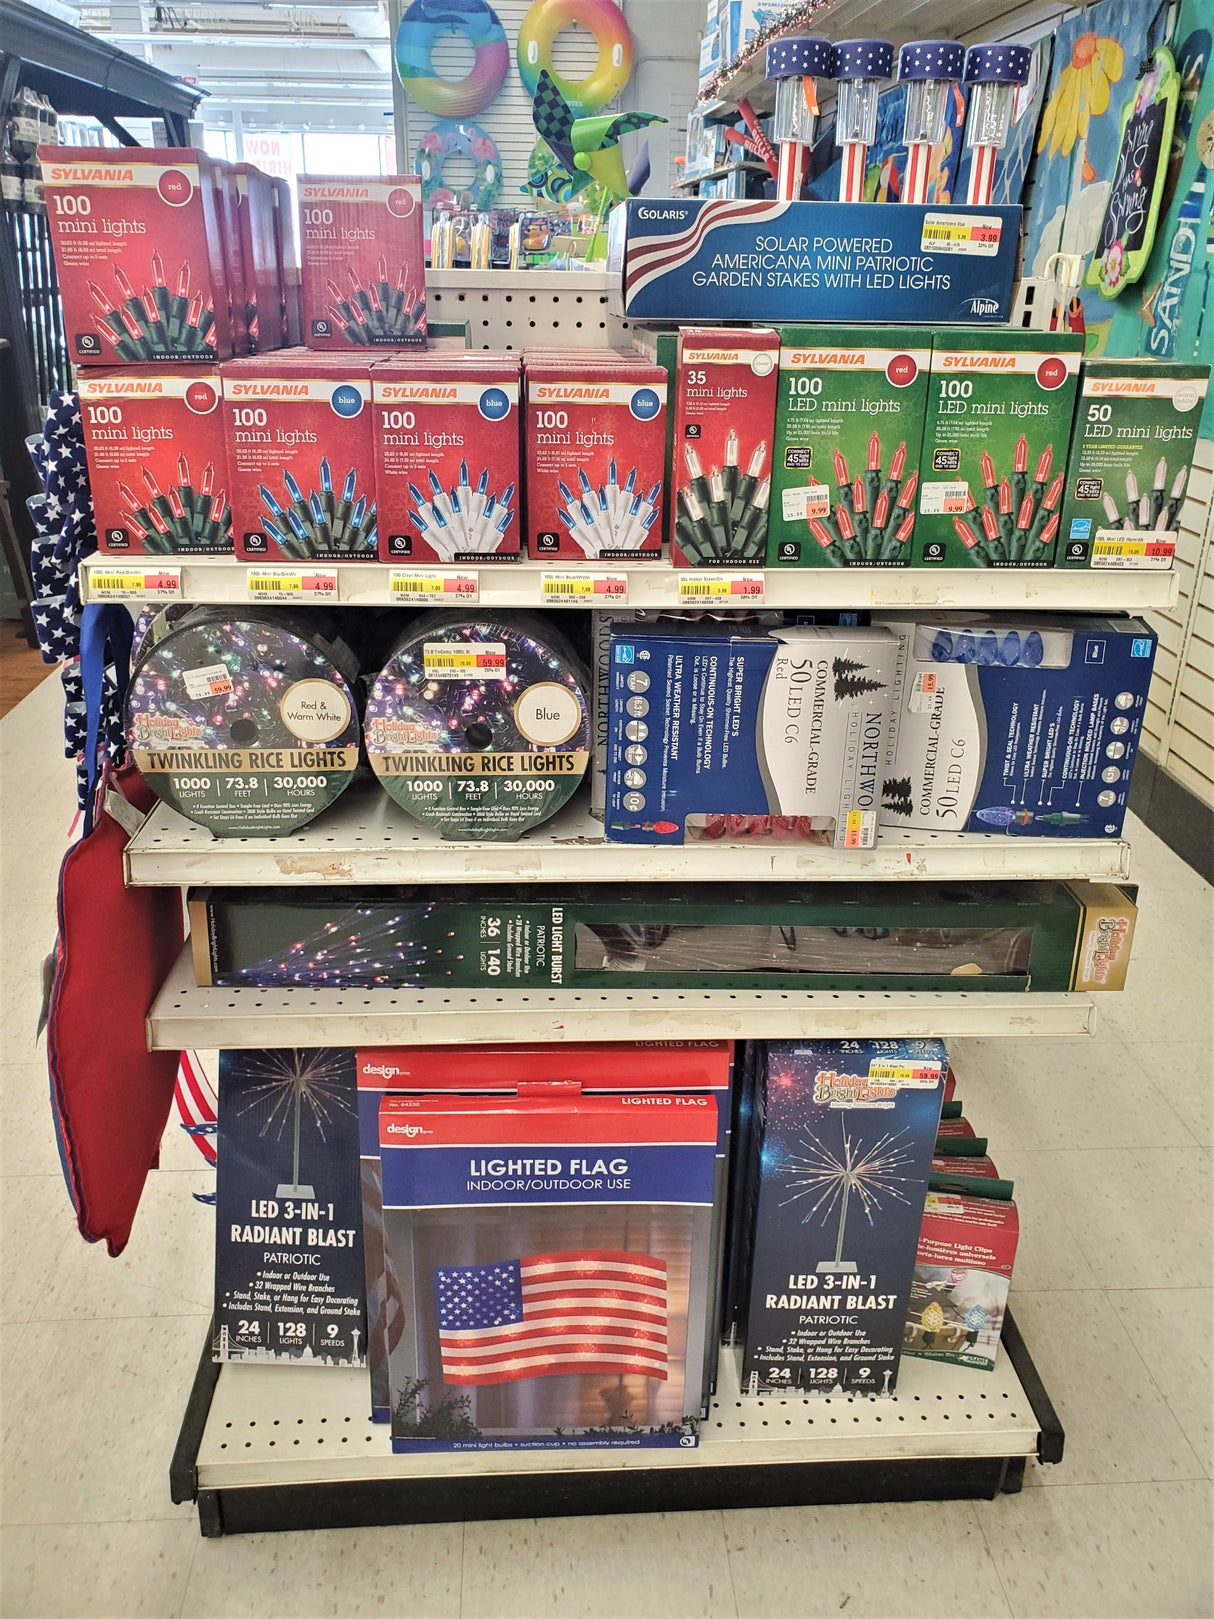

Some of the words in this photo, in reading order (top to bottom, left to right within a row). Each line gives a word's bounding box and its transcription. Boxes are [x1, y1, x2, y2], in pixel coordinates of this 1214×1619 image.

[51, 168, 133, 181] SYLVANIA
[304, 187, 369, 198] SYLVANIA
[53, 195, 91, 215] 100
[304, 209, 333, 225] 100
[57, 219, 98, 233] mini
[102, 219, 147, 237] lights
[305, 228, 337, 239] mini
[340, 228, 376, 242] lights
[755, 236, 808, 252] SOLAR
[813, 237, 893, 253] POWERED
[981, 234, 997, 243] 3.99
[712, 254, 812, 270] AMERICANA
[817, 255, 851, 271] MINI
[856, 256, 934, 272] PATRIOTIC
[692, 271, 763, 287] GARDEN
[766, 272, 820, 288] STAKES
[824, 273, 861, 289] WITH
[866, 274, 895, 289] LED
[899, 274, 951, 290] LIGHTS
[1150, 227, 1196, 355] SAND
[970, 298, 999, 315] Alpine
[688, 352, 738, 361] SYLVANIA
[791, 353, 865, 365] SYLVANIA
[943, 356, 1016, 367] SYLVANIA
[687, 371, 706, 385] 35
[788, 377, 822, 395] 100
[86, 383, 163, 394] SYLVANIA
[232, 384, 309, 395] SYLVANIA
[381, 387, 457, 399] SYLVANIA
[536, 387, 610, 399] SYLVANIA
[717, 387, 748, 400] lights
[939, 380, 973, 398] 100
[1091, 382, 1156, 392] SYLVANIA
[88, 406, 122, 424] 100
[788, 397, 817, 411] LED
[821, 399, 856, 412] mini
[860, 399, 900, 416] lights
[938, 401, 967, 414] LED
[971, 402, 1005, 415] mini
[1010, 402, 1049, 418] lights
[1087, 404, 1112, 421] 50
[233, 408, 267, 426] 100
[381, 411, 415, 429] 100
[536, 411, 568, 428] 100
[91, 427, 128, 440] mini
[131, 426, 173, 443] lights
[235, 429, 272, 442] mini
[276, 429, 317, 446] lights
[383, 432, 419, 445] mini
[423, 432, 464, 449] lights
[536, 432, 571, 445] mini
[575, 431, 614, 448] lights
[1084, 424, 1113, 438] LED
[1116, 425, 1150, 438] mini
[1154, 425, 1193, 441] lights
[811, 507, 827, 515] 9.99
[1151, 547, 1173, 557] 10.99
[158, 580, 177, 589] 4.99
[315, 582, 334, 590] 4.99
[743, 586, 761, 594] 1.99
[482, 659, 505, 667] 59.99
[674, 655, 683, 679] ULTRA
[735, 656, 745, 682] SUPER
[776, 658, 789, 680] Red
[790, 659, 813, 684] 50
[214, 684, 232, 694] 59.99
[301, 701, 317, 710] Red
[672, 682, 682, 718] WEATHER
[732, 685, 742, 713] BRIGHT
[786, 687, 803, 719] LED
[286, 712, 314, 721] Warm
[315, 712, 342, 722] White
[535, 707, 561, 720] Blue
[731, 715, 740, 736] LED'S
[805, 660, 828, 794] COMMERCIAL-GRADE
[670, 720, 680, 760] RESISTANT
[147, 752, 243, 769] TWINKLING
[249, 752, 282, 769] RICE
[290, 751, 347, 768] LIGHTS
[382, 755, 475, 772] TWINKLING
[481, 755, 514, 772] RICE
[520, 754, 575, 772] LIGHTS
[857, 713, 883, 811] NORTHWO
[173, 777, 211, 790] 1000
[225, 777, 259, 789] 73.8
[273, 776, 328, 790] 30,000
[406, 780, 443, 792] 1000
[457, 780, 489, 792] 73.8
[503, 780, 555, 793] 30,000
[945, 764, 963, 794] LED
[179, 790, 206, 798] LIGHTS
[287, 789, 316, 797] HOURS
[936, 796, 958, 818] 50
[552, 907, 563, 924] LED
[487, 917, 501, 937] 36
[536, 925, 545, 967] PATRIOTIC
[551, 926, 563, 953] LIGHT
[487, 949, 501, 976] 140
[551, 955, 562, 984] BURST
[362, 1063, 400, 1079] design
[621, 1097, 672, 1105] LIGHTED
[675, 1098, 708, 1106] FLAG
[386, 1123, 424, 1138] design
[470, 1159, 563, 1176] LIGHTED
[569, 1158, 629, 1176] FLAG
[467, 1179, 603, 1192] INDOOR/OUTDOOR
[607, 1177, 631, 1190] USE
[251, 1200, 279, 1219] LED
[284, 1201, 334, 1221] 3-IN-1
[231, 1225, 303, 1245] RADIANT
[307, 1229, 356, 1248] BLAST
[954, 1242, 973, 1251] Light
[263, 1252, 321, 1266] PATRIOTIC
[262, 1270, 283, 1279] Indoor
[293, 1272, 317, 1281] Outdoor
[319, 1273, 330, 1282] Use
[788, 1274, 819, 1290] LED
[823, 1274, 877, 1290] 3-IN-1
[228, 1303, 253, 1311] Includes
[306, 1306, 318, 1314] and
[320, 1306, 342, 1315] Ground
[344, 1307, 360, 1316] Stake
[765, 1294, 842, 1309] RADIANT
[846, 1295, 897, 1310] BLAST
[799, 1315, 859, 1325] PATRIOTIC
[238, 1320, 261, 1334] 24
[277, 1322, 306, 1337] 128
[326, 1324, 339, 1338] 9
[235, 1335, 262, 1343] INCHES
[279, 1337, 303, 1345] LIGHTS
[320, 1339, 345, 1347] SPEEDS
[768, 1367, 792, 1379] 24
[809, 1367, 838, 1379] 128
[858, 1367, 871, 1379] 9
[611, 1439, 640, 1447] required
